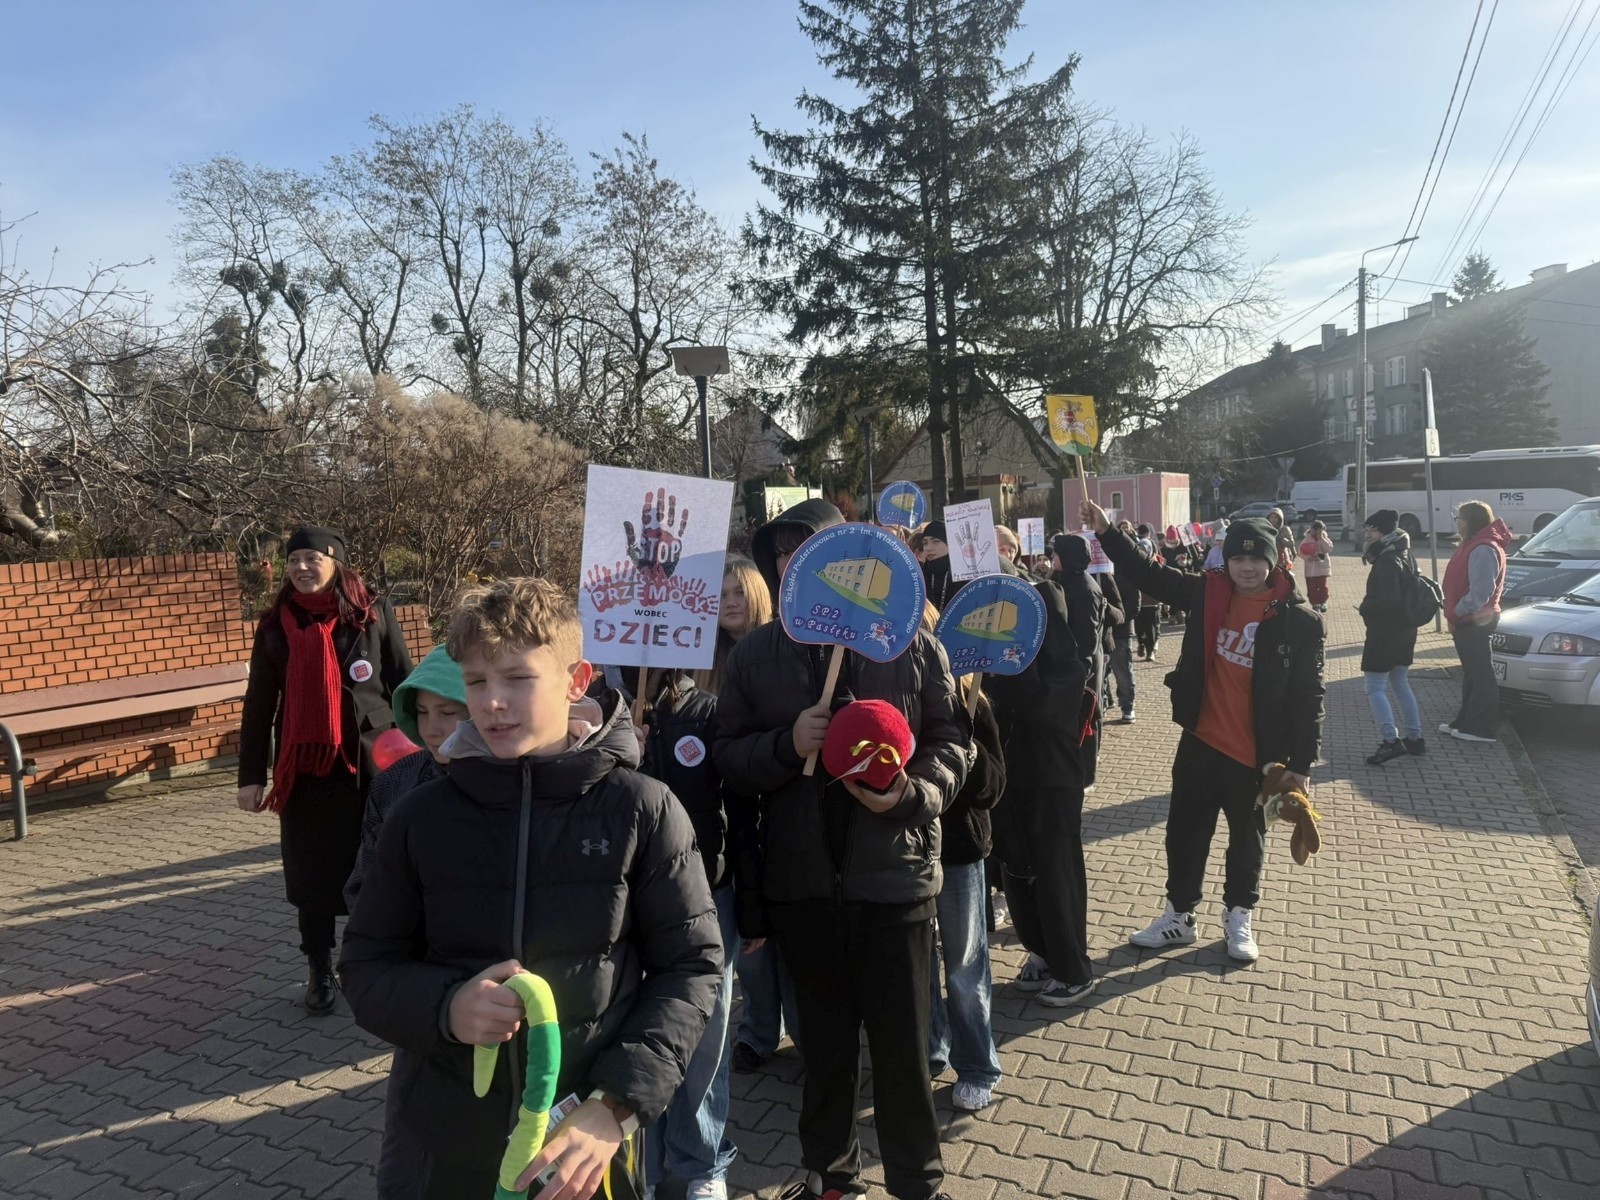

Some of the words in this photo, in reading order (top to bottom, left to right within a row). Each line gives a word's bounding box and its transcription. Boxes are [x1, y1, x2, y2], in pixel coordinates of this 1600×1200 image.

[1500, 492, 1524, 501] PKS
[634, 537, 681, 564] STOP
[793, 532, 835, 573] Podstawowa
[837, 529, 847, 537] nr
[849, 526, 856, 534] 2
[876, 531, 913, 571] Władysława
[906, 571, 923, 634] Broniewskiego
[634, 608, 668, 618] WOBEC
[812, 605, 830, 616] SP
[832, 609, 839, 619] 2
[795, 618, 804, 626] w
